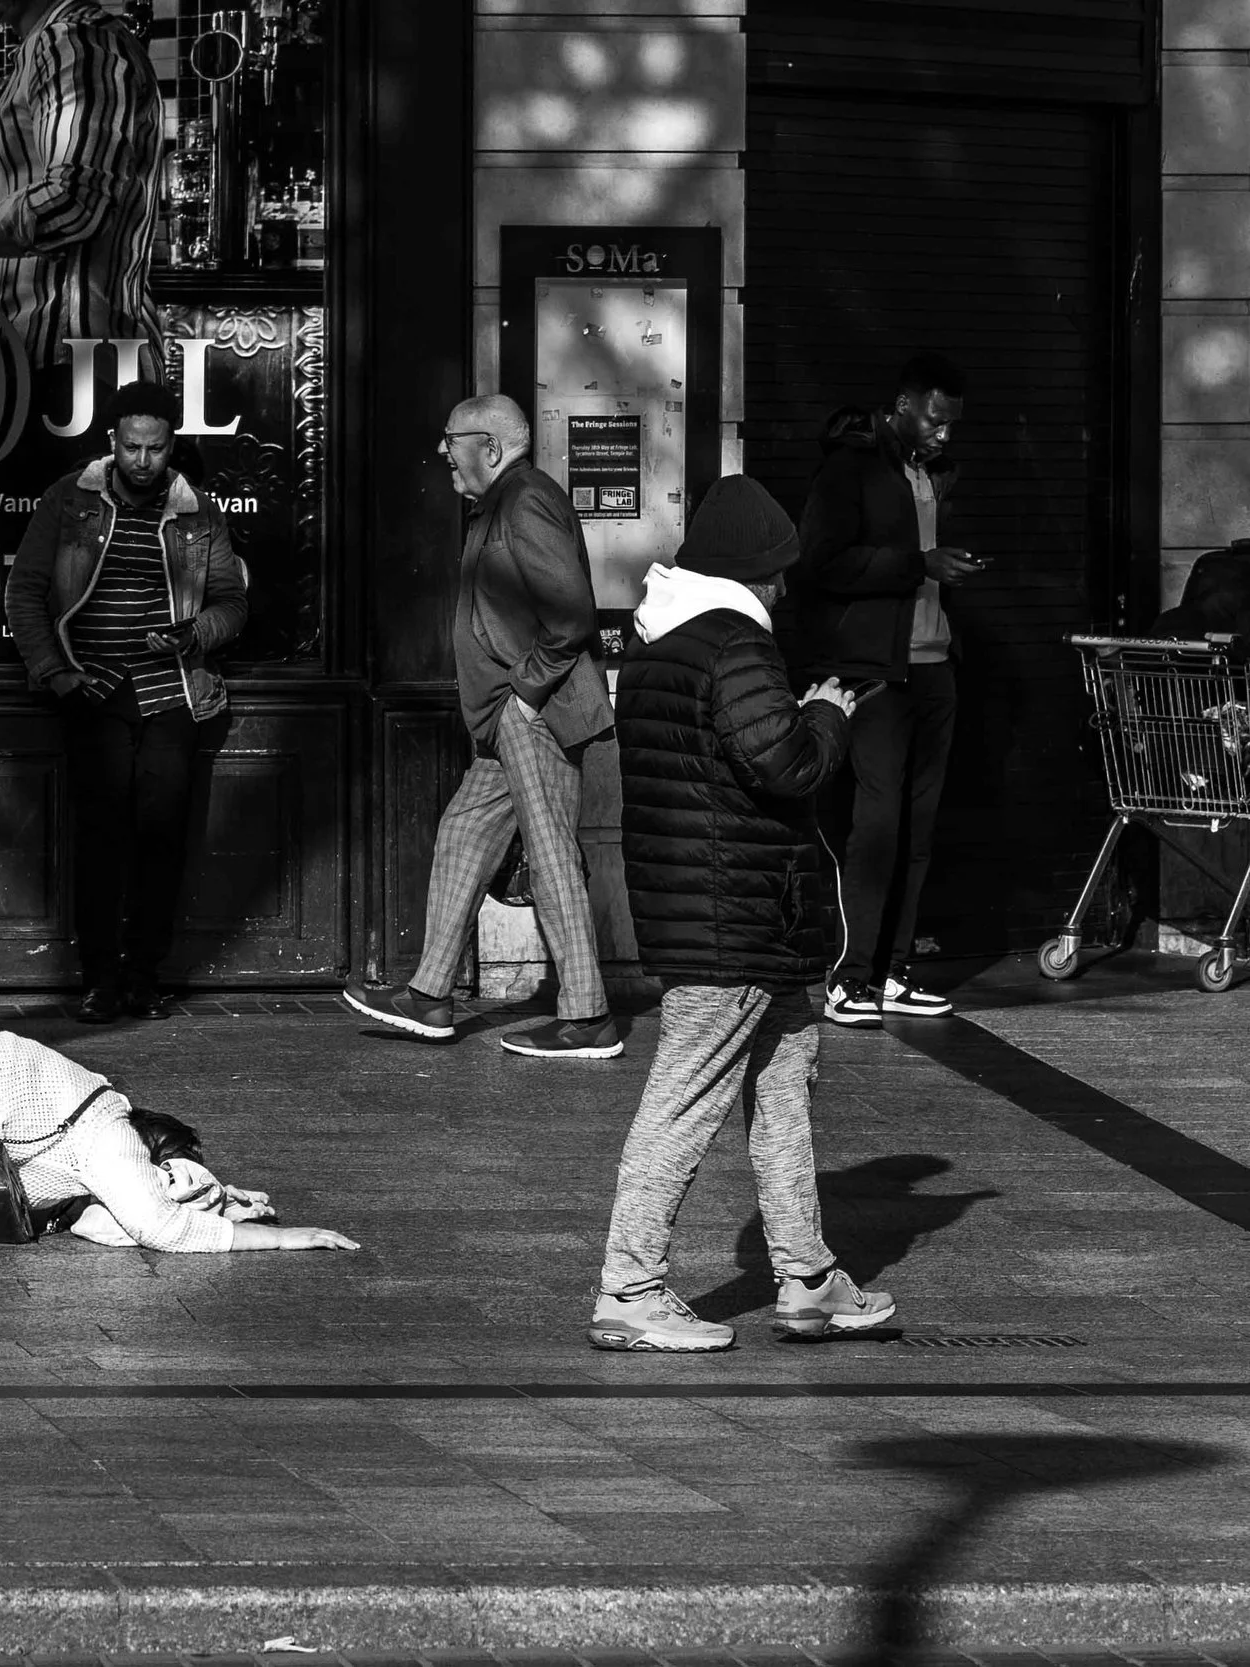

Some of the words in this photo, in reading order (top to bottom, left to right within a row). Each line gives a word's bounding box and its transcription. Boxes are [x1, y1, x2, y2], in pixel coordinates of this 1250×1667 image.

[571, 420, 584, 428] The
[585, 420, 607, 429] Fringe
[608, 420, 638, 428] Sessions
[602, 490, 632, 498] FRINGE
[616, 498, 632, 506] LAB
